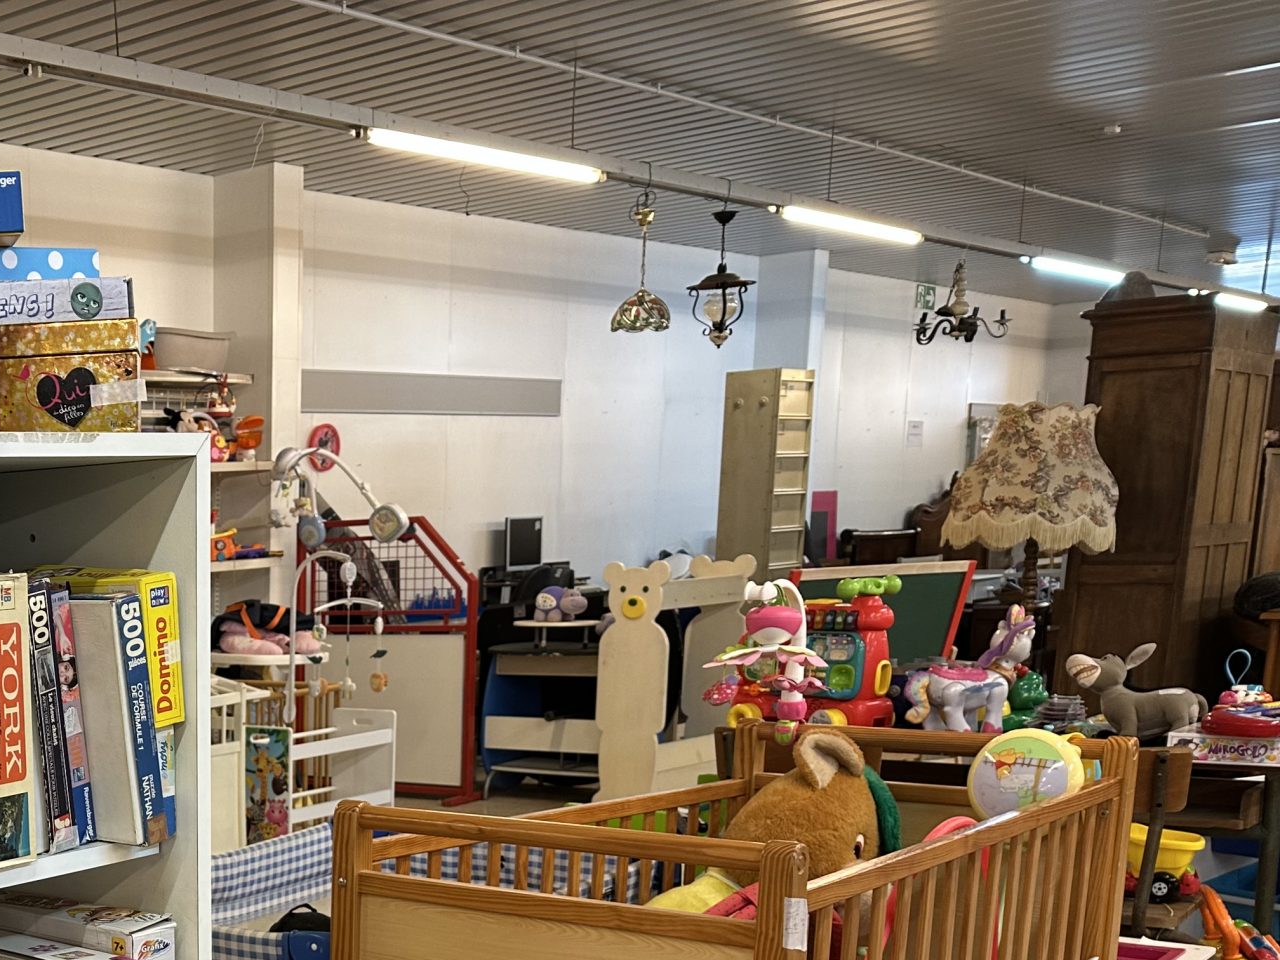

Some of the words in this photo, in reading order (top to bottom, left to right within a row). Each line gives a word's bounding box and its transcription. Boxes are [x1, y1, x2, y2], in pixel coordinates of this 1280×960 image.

[31, 595, 48, 644] 500
[121, 602, 145, 657] 500
[153, 617, 172, 714] Domino
[0, 627, 22, 777] YORK
[130, 685, 138, 699] DE
[136, 682, 147, 720] COURSE
[131, 700, 143, 744] FORMULE
[142, 776, 153, 820] NATHAN
[113, 942, 124, 952] 7+
